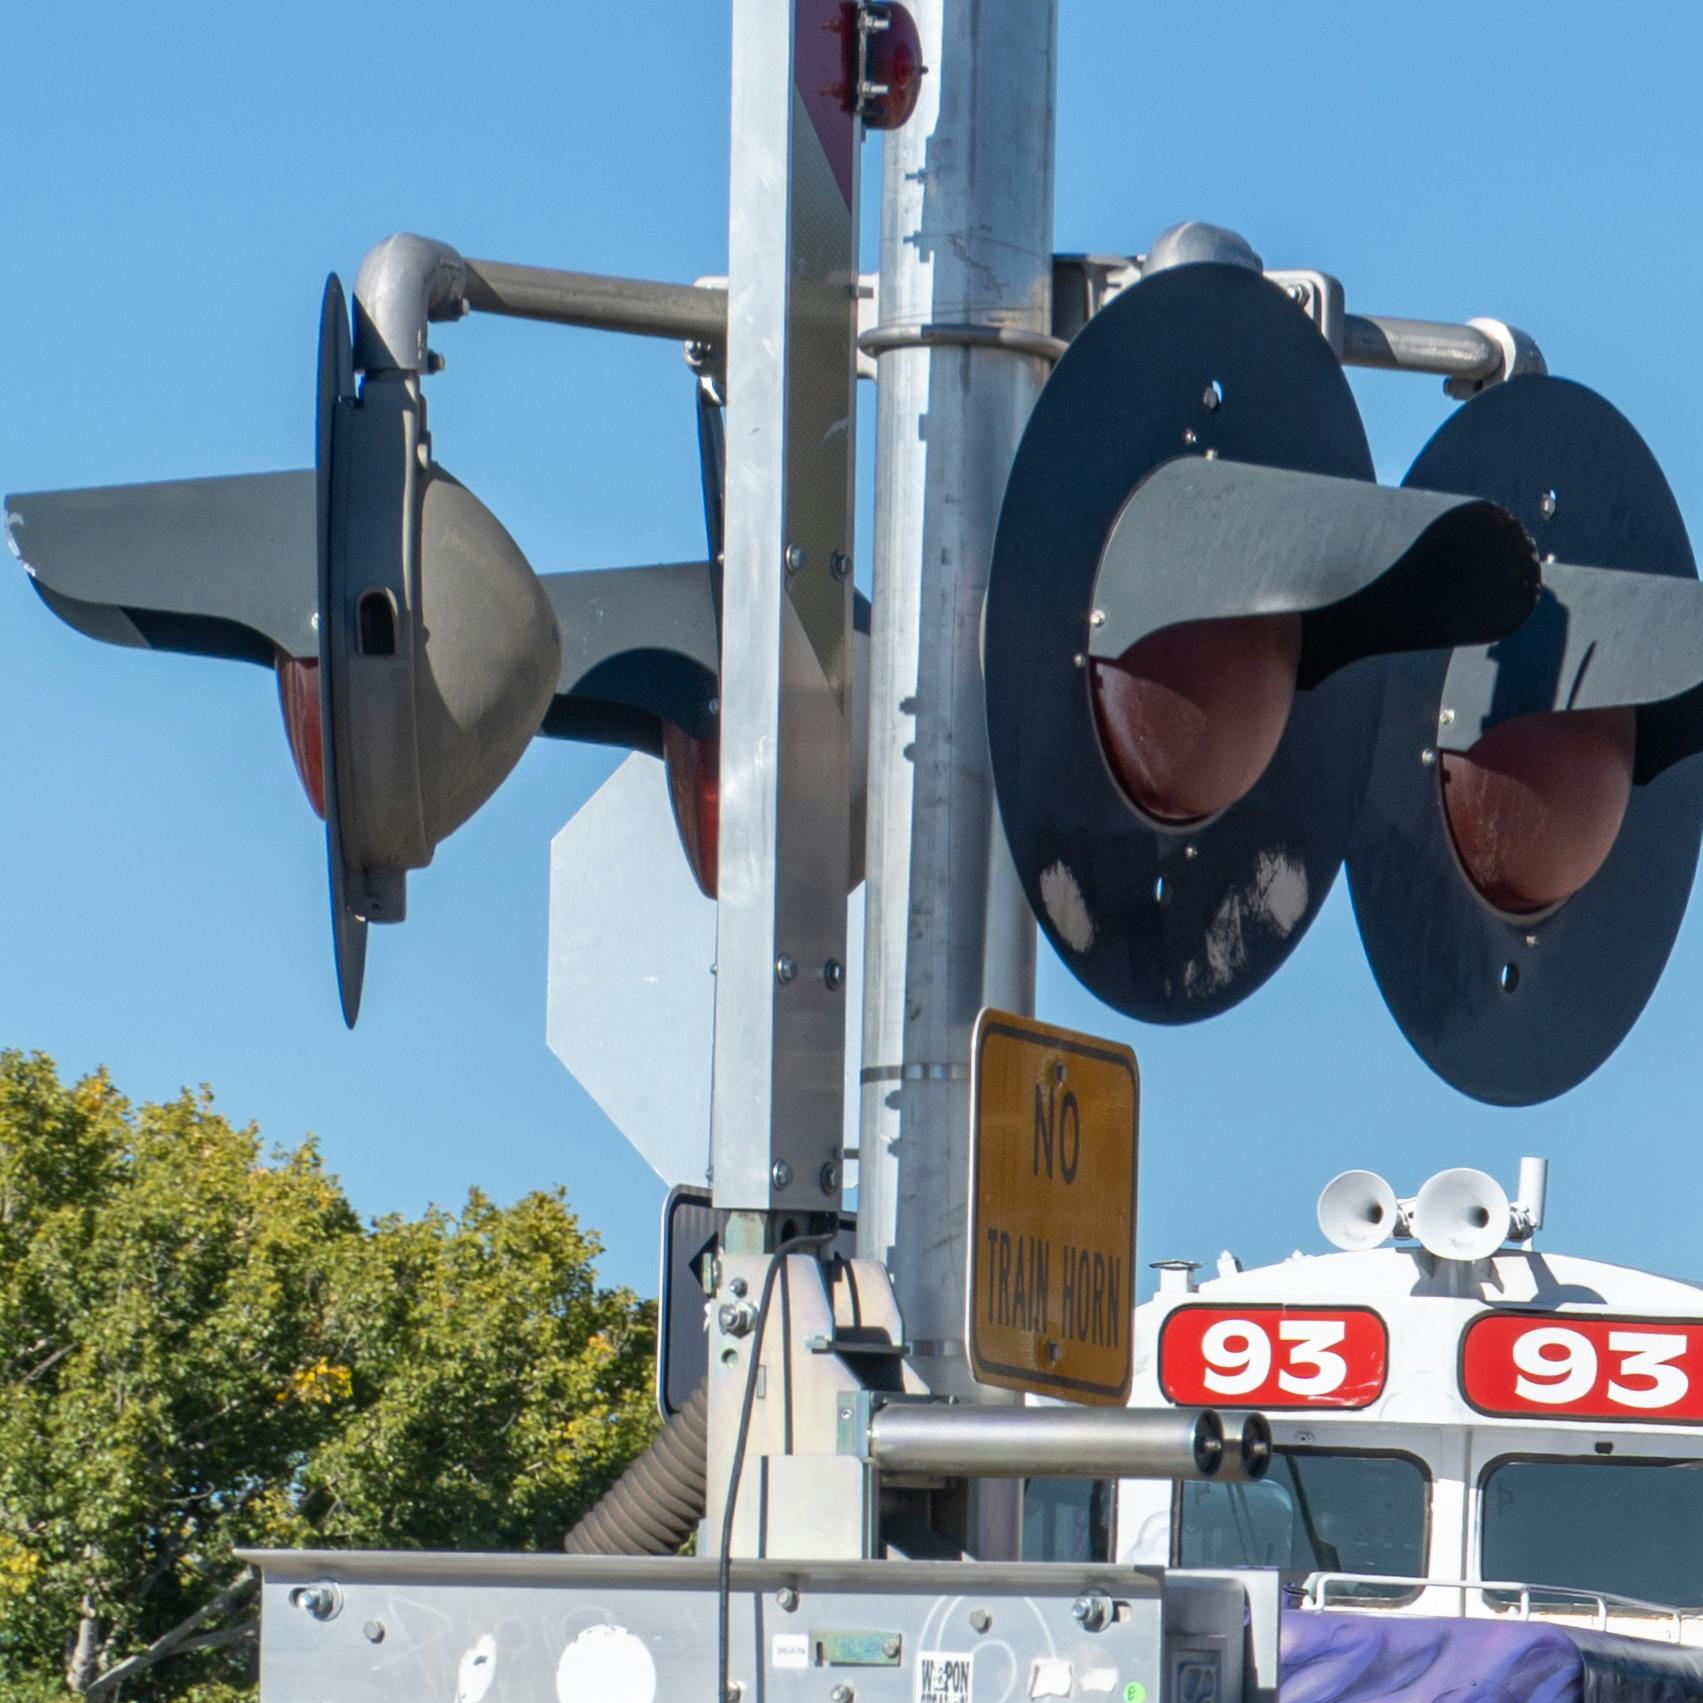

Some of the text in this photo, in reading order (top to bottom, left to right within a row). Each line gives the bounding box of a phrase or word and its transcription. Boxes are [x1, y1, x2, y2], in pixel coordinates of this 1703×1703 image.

[1033, 1083, 1080, 1184] NO
[987, 1227, 1120, 1349] TRAIN HORN
[1201, 1318, 1347, 1396] 93
[1513, 1327, 1690, 1410] 93
